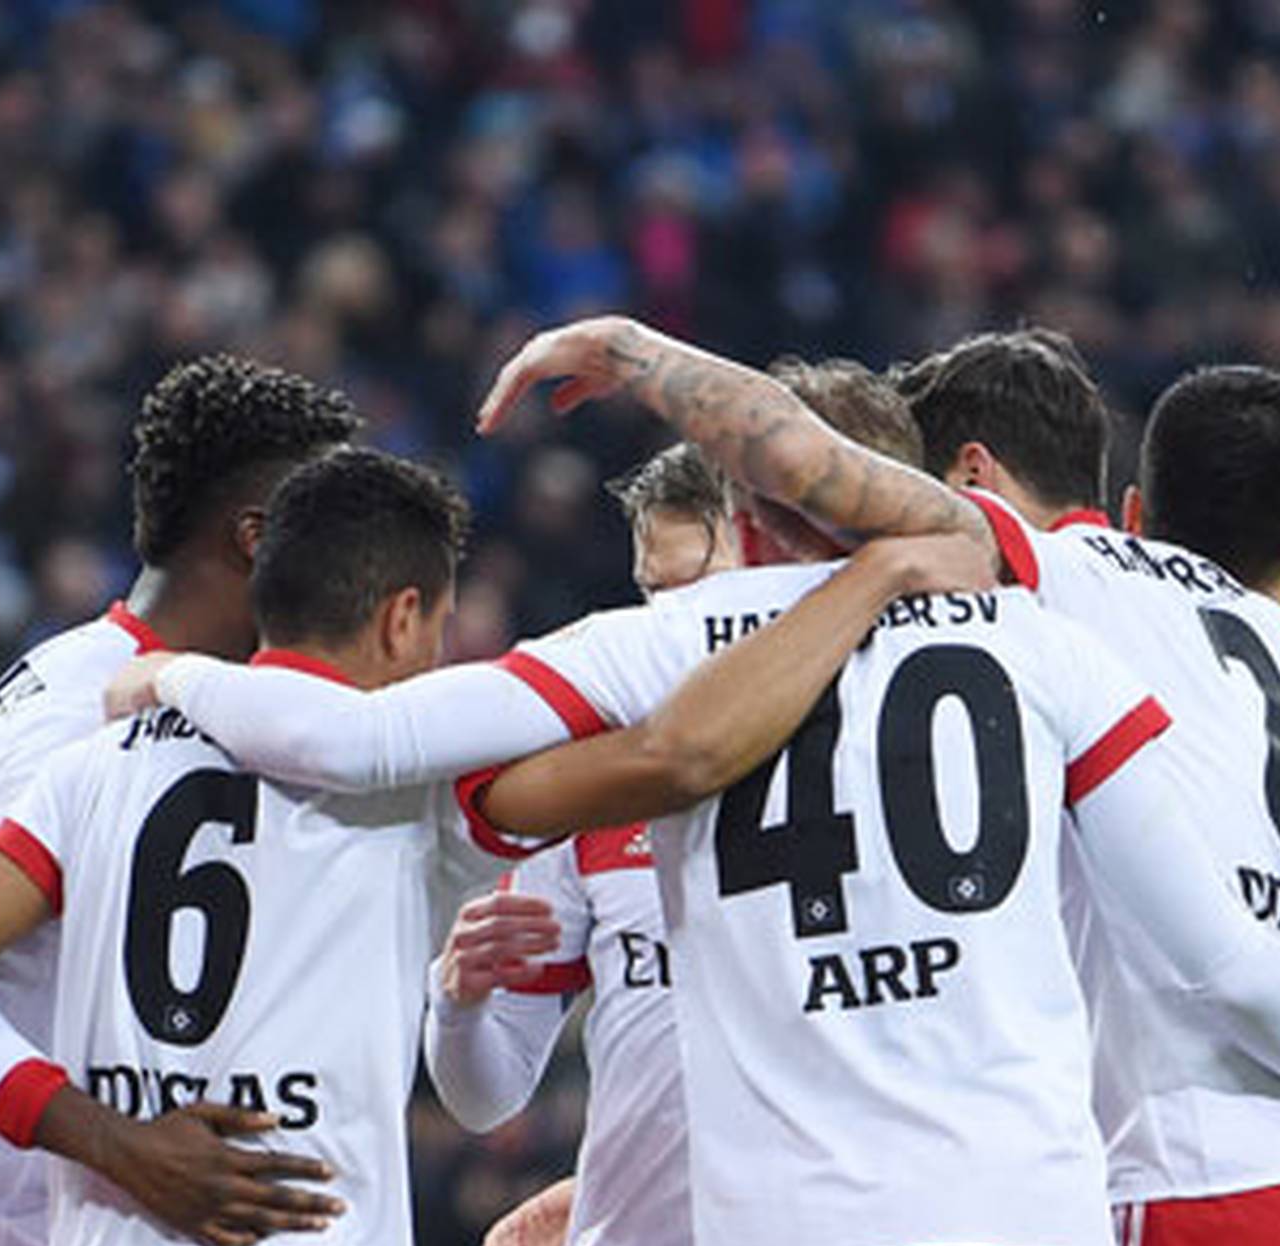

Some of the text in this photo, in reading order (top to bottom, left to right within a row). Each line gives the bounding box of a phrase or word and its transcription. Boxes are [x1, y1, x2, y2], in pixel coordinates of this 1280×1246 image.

[122, 768, 258, 1048] 6
[716, 643, 1030, 939] 40
[802, 937, 961, 1013] ARP
